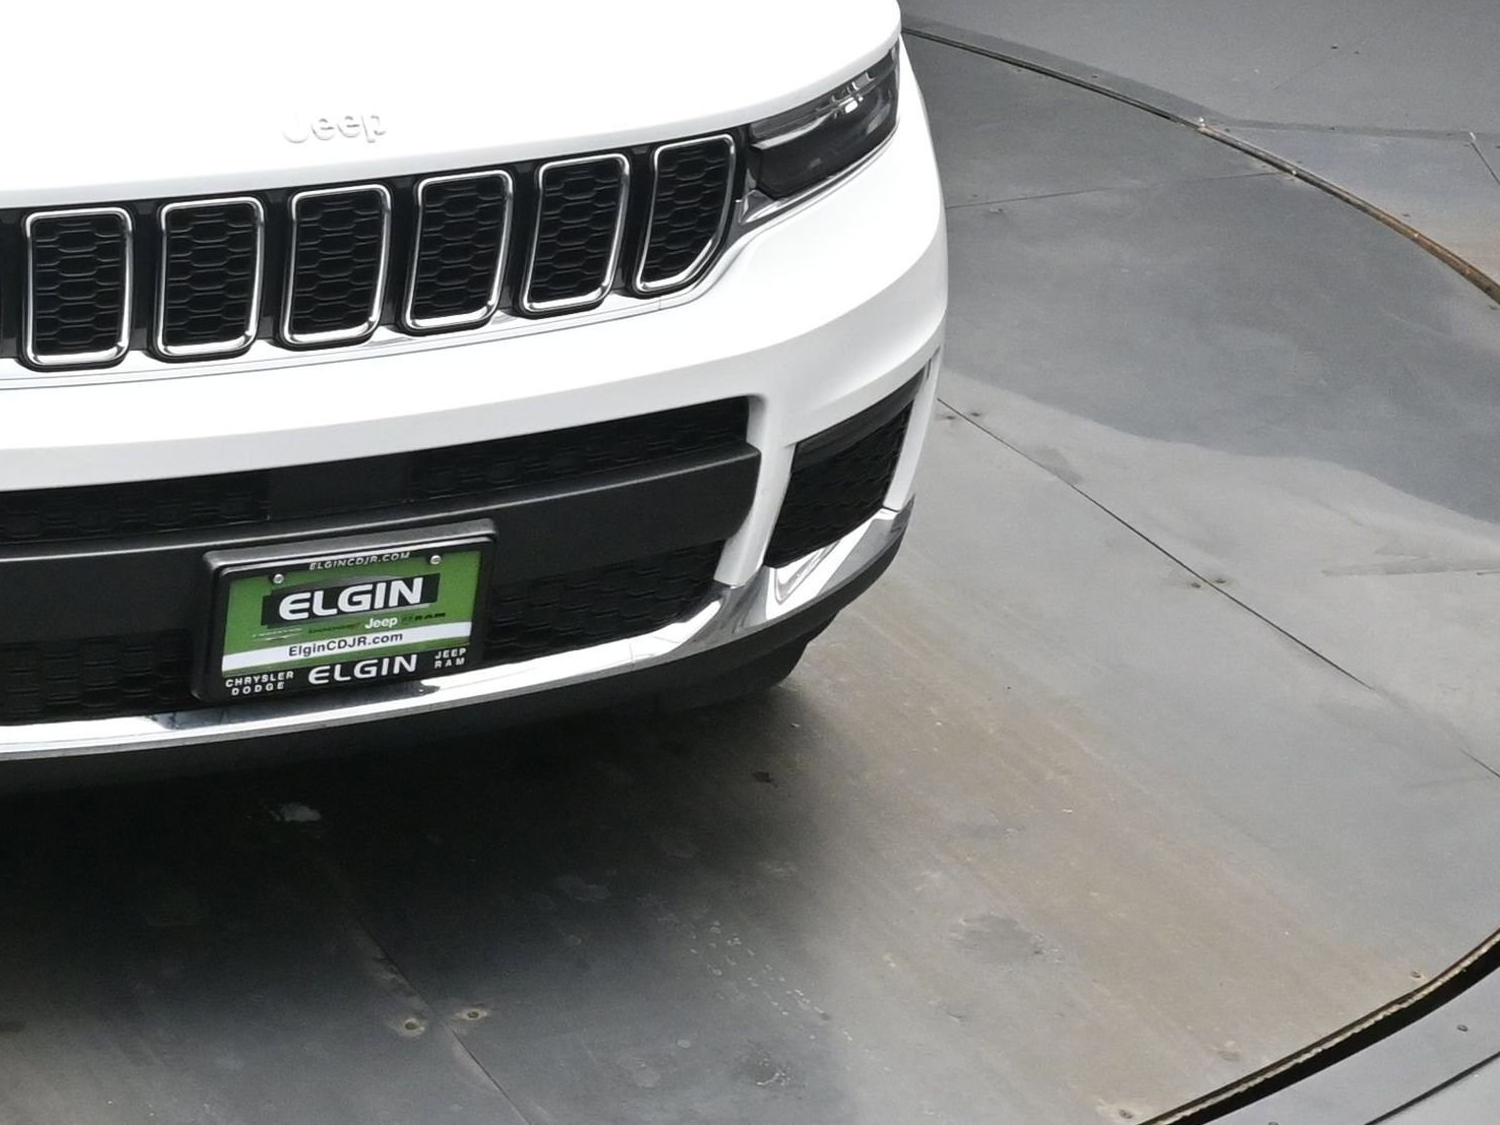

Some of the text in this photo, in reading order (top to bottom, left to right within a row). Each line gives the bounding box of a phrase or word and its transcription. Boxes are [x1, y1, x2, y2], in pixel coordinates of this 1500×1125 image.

[281, 110, 387, 144] Jeep
[309, 552, 410, 571] ELGINCDJR.COM
[279, 577, 423, 620] ELGIN
[364, 616, 398, 630] Jeep
[288, 633, 403, 657] ElginCDJR.com
[435, 648, 467, 660] JEEP
[308, 654, 418, 685] ELGIN
[434, 658, 466, 669] RAM
[225, 671, 294, 688] CHRYSLER
[231, 682, 285, 696] DODGE
